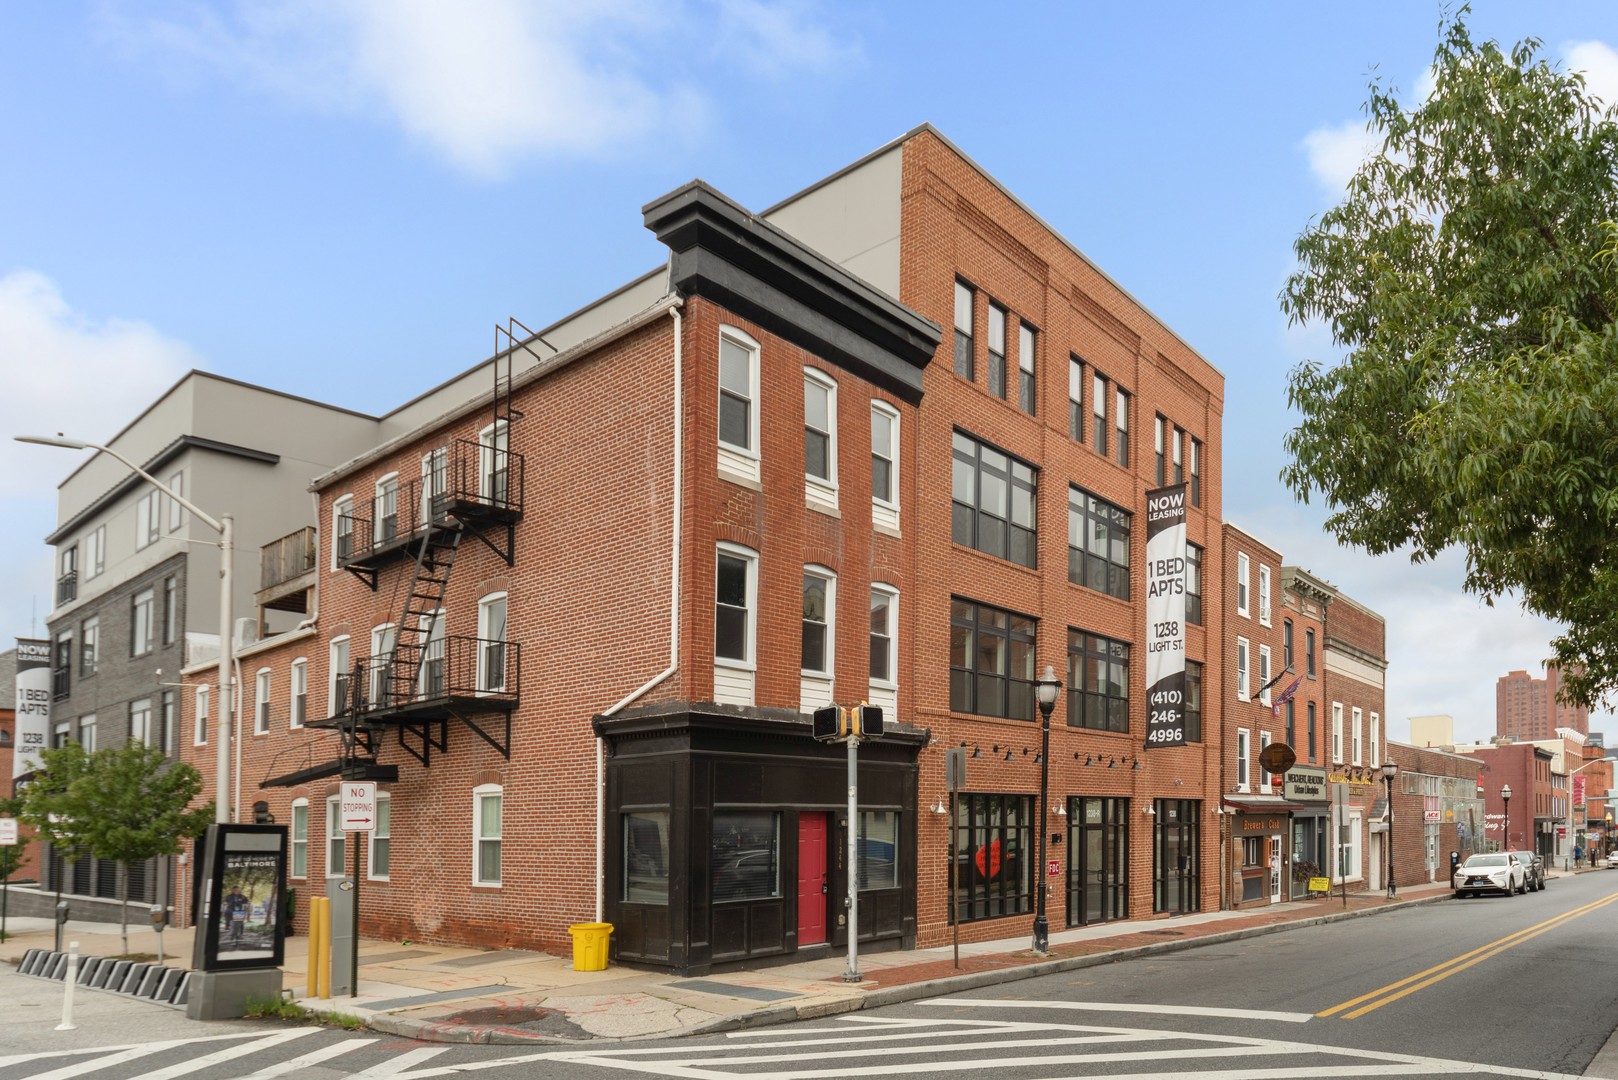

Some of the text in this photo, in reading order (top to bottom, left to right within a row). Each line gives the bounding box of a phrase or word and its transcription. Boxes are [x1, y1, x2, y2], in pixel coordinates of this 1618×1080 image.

[1149, 493, 1184, 512] NOW
[1149, 507, 1184, 521] LEASING
[1148, 557, 1185, 578] 1 BED
[1148, 578, 1183, 598] APTS
[1154, 621, 1178, 638] 1238
[18, 644, 50, 656] NOW
[1149, 639, 1184, 653] LIGHT ST.
[18, 654, 50, 663] LEASING
[18, 688, 49, 702] 1 BED
[1151, 690, 1182, 706] (410)
[18, 703, 48, 716] APTS
[1150, 710, 1181, 724] 246-
[22, 732, 43, 744] 1238
[1149, 728, 1182, 742] 4996
[351, 788, 365, 798] NO
[343, 803, 373, 813] STOPPING
[1049, 863, 1060, 873] FDC
